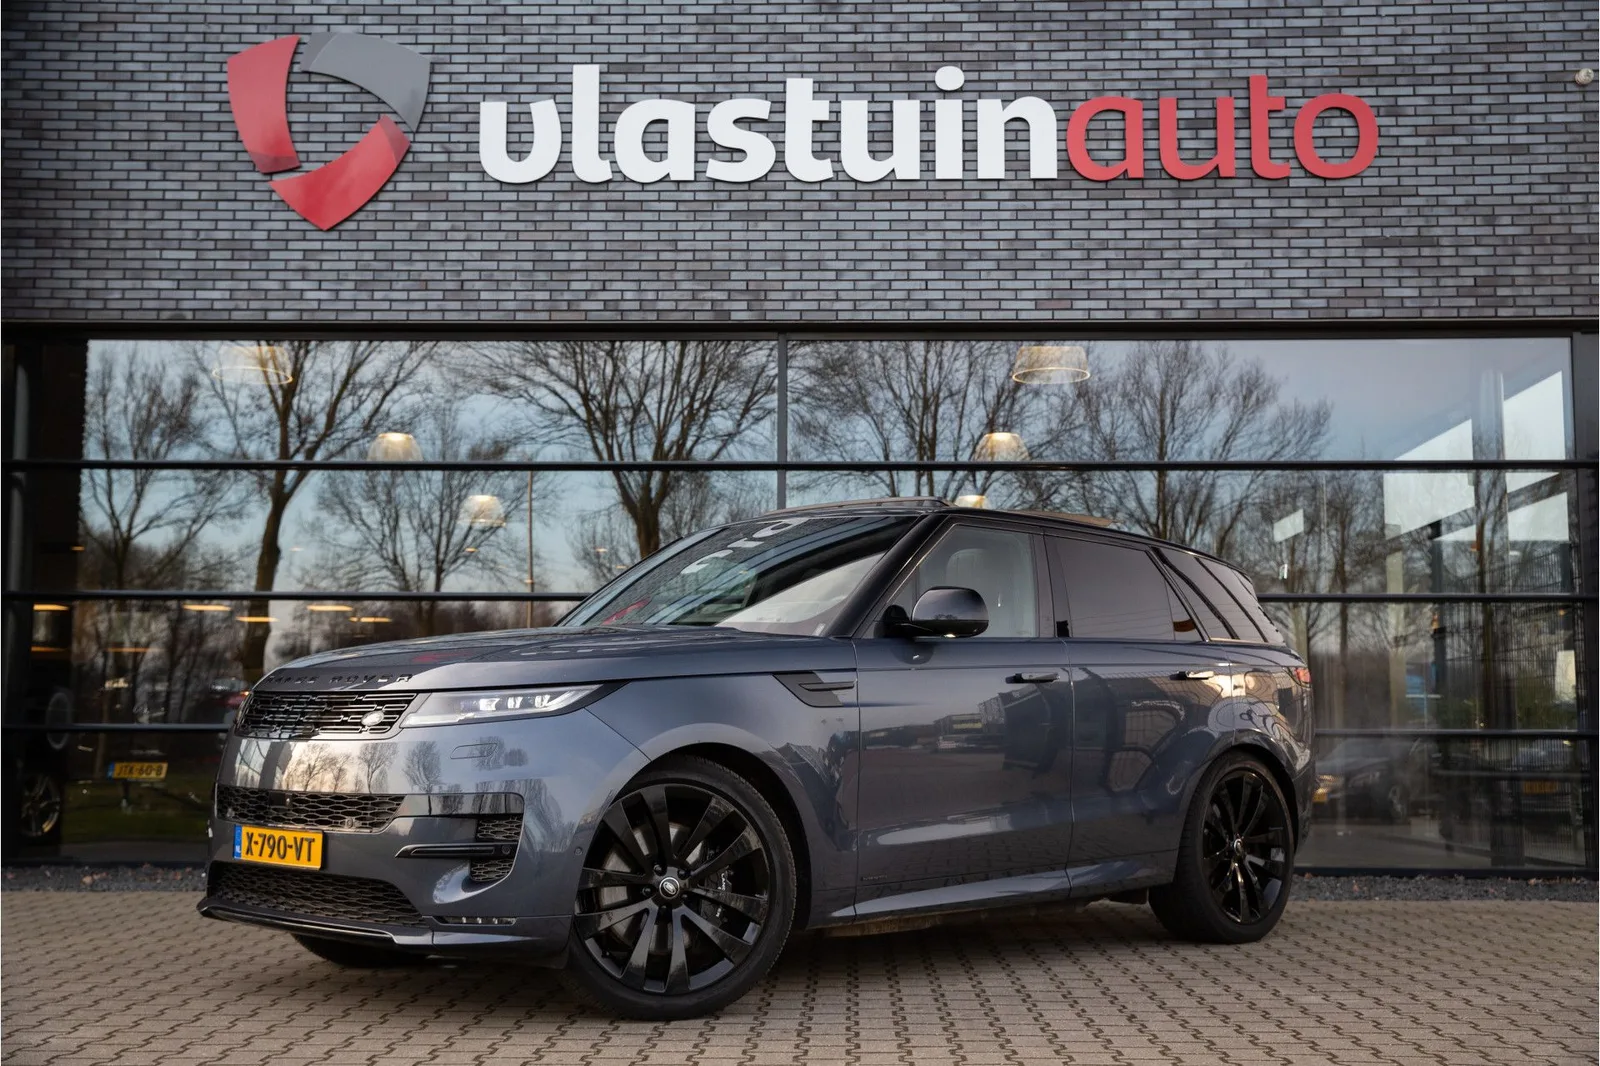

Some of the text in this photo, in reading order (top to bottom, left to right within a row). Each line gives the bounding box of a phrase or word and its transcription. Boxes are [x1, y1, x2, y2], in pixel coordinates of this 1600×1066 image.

[479, 64, 1380, 184] vlastuinauto
[329, 674, 413, 684] ROVER
[245, 832, 316, 862] X-790-VT
